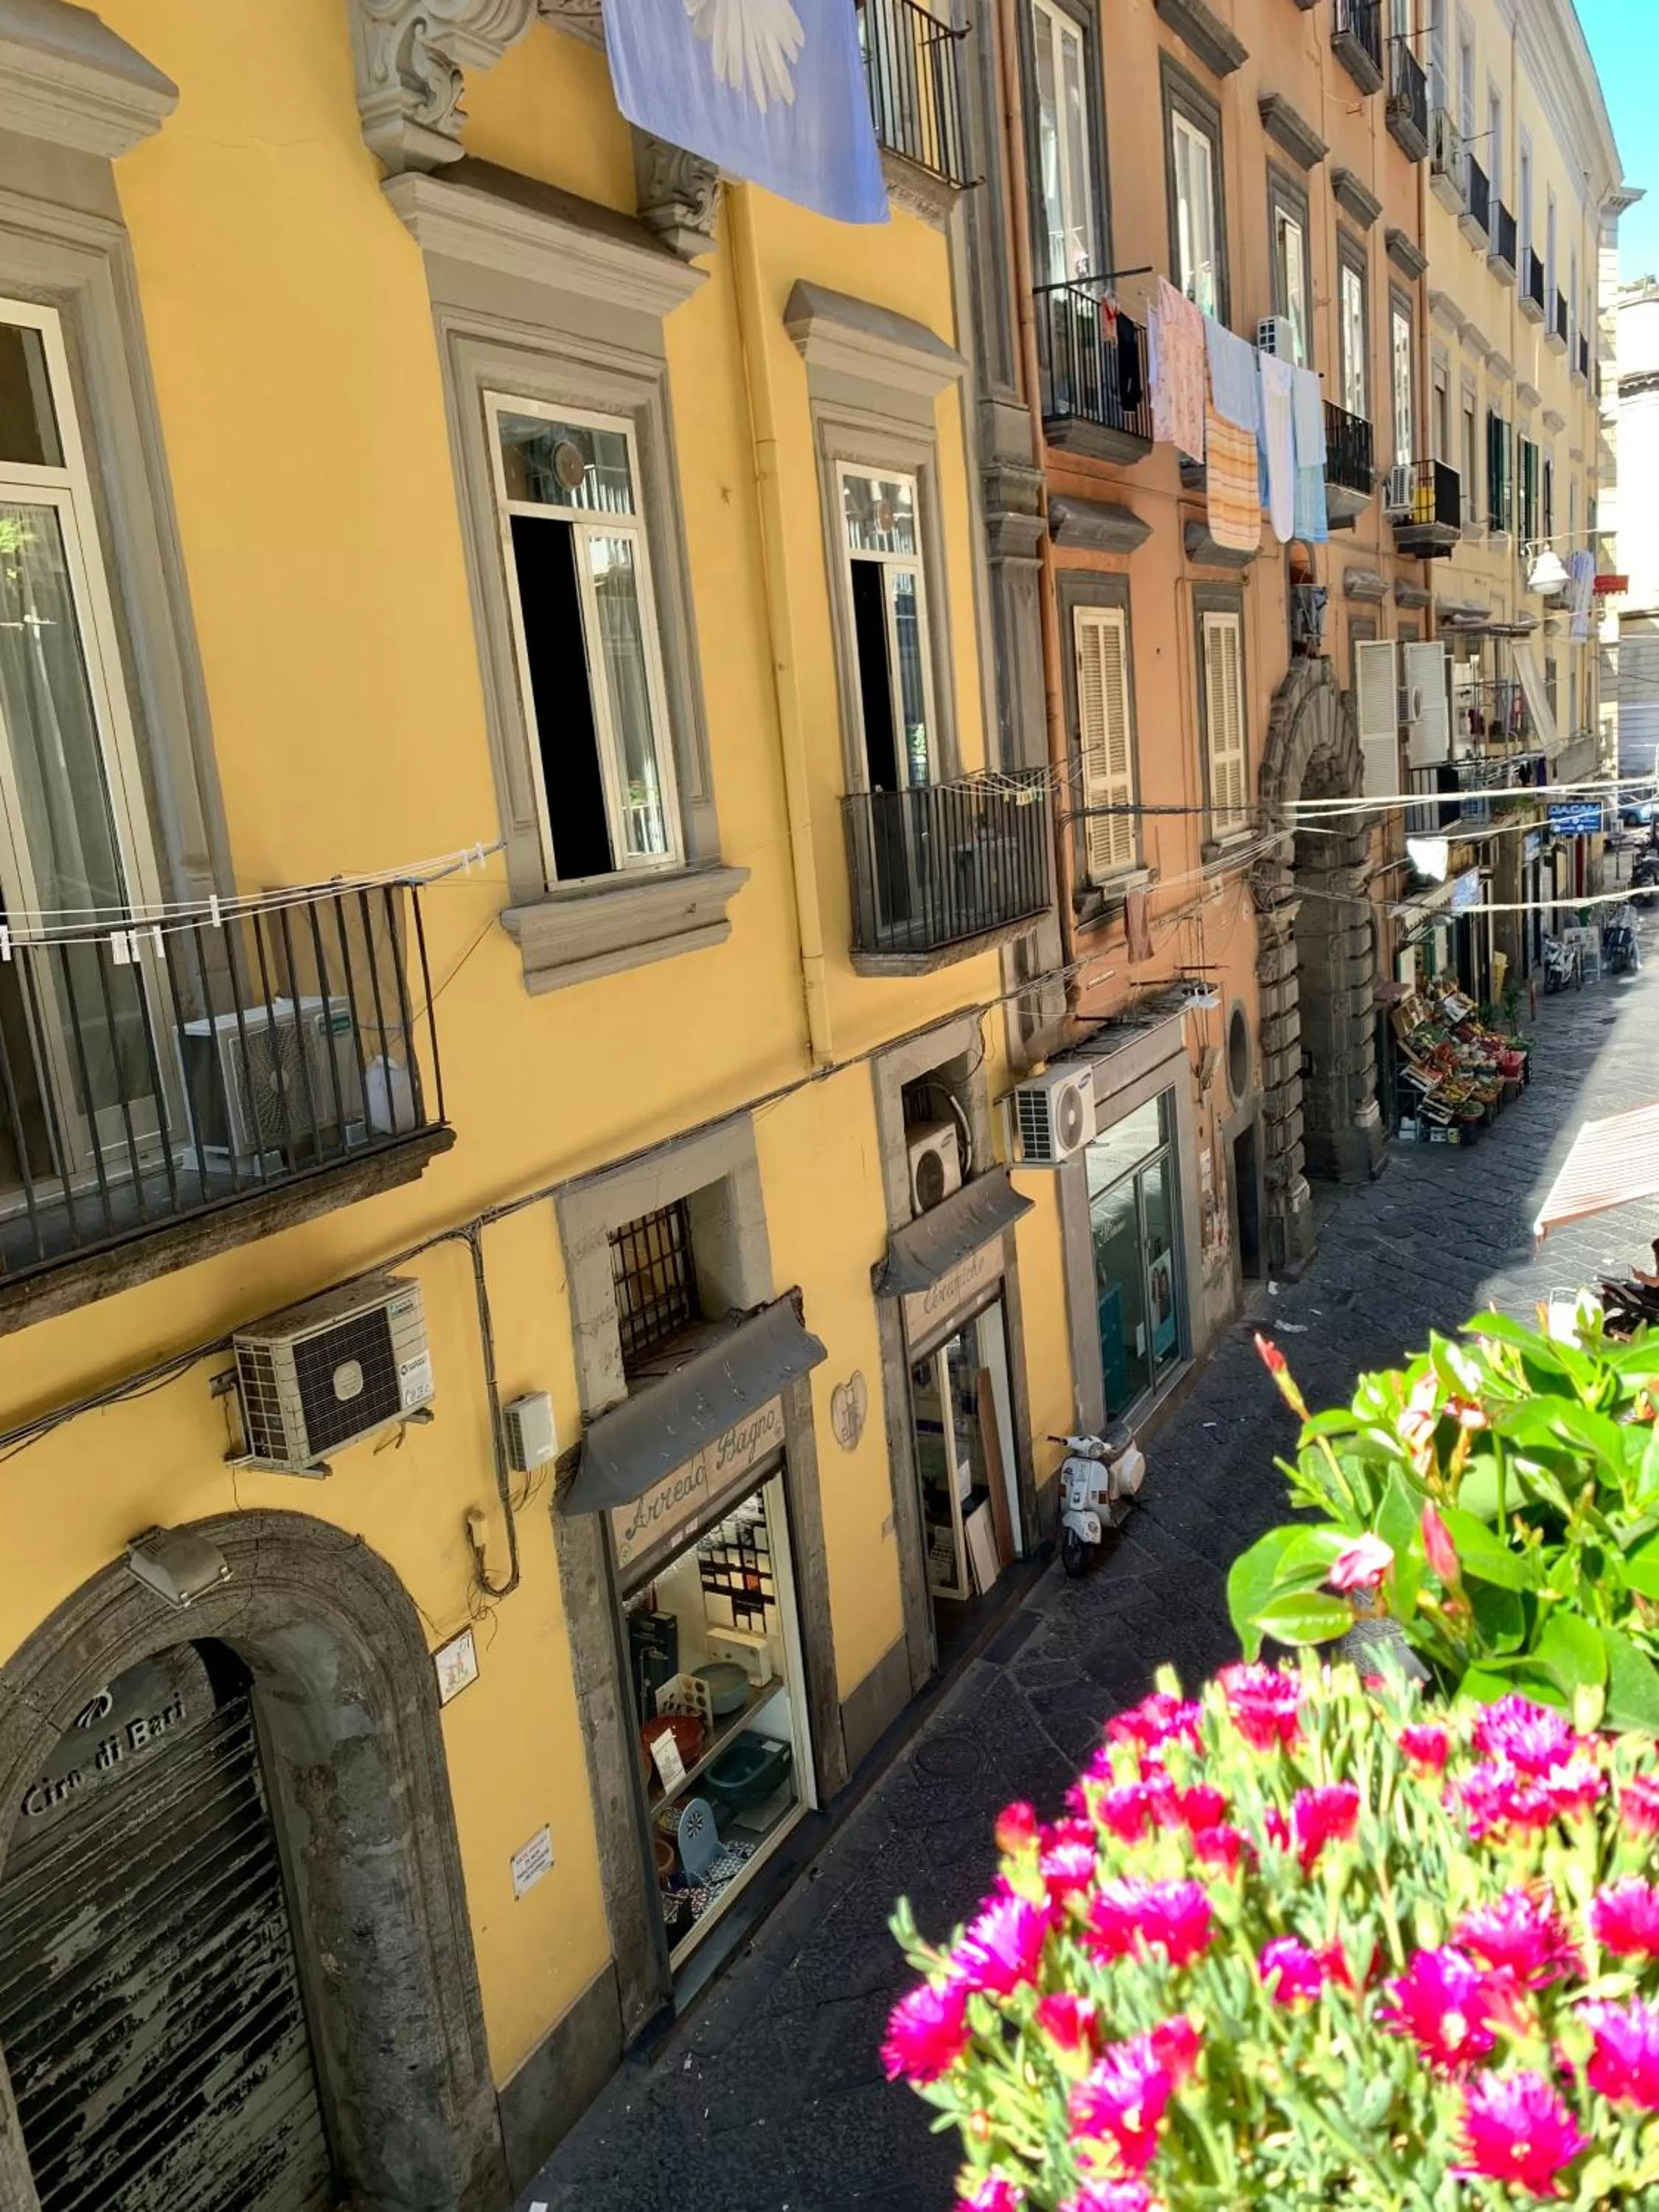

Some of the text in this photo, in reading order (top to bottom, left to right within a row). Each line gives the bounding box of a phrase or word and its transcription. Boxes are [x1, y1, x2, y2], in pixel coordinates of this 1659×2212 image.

[625, 1409, 775, 1542] Arredo Bagno
[95, 1734, 124, 1770] di
[125, 1691, 187, 1750] Bari
